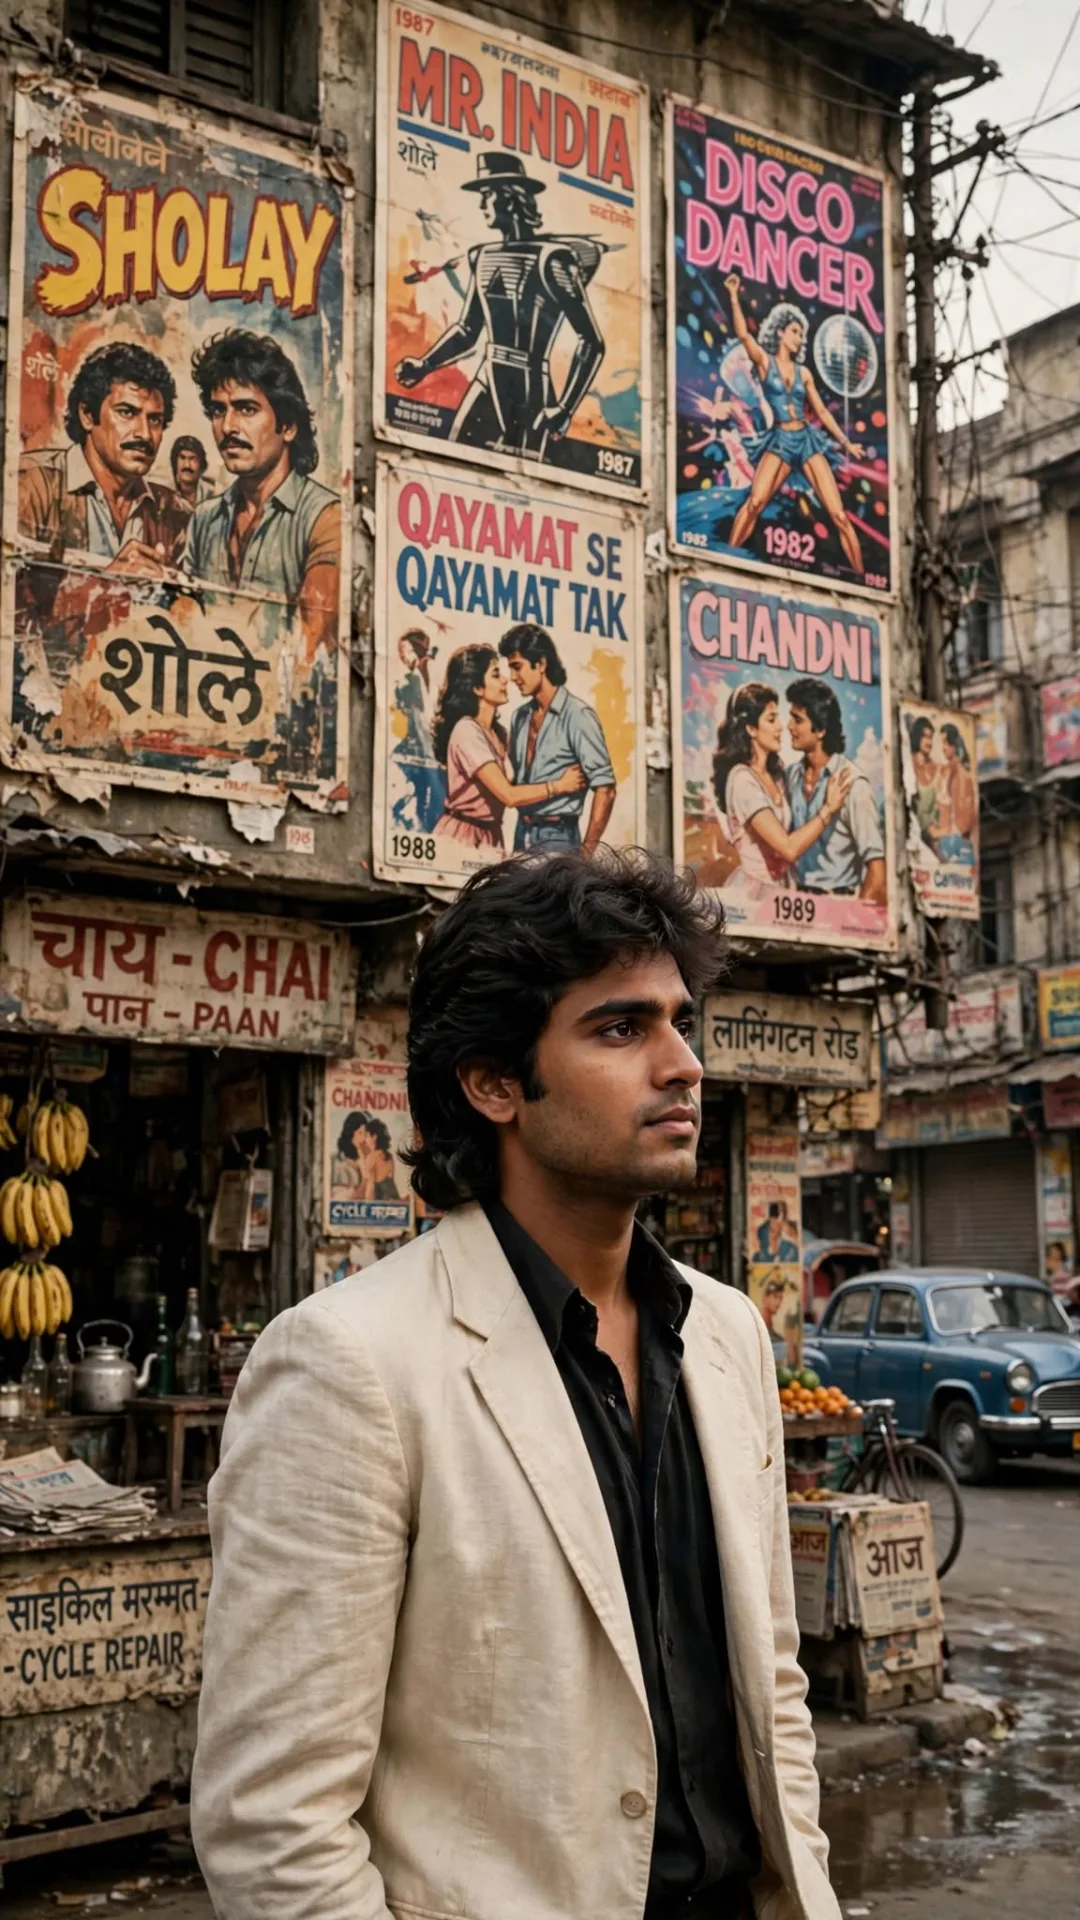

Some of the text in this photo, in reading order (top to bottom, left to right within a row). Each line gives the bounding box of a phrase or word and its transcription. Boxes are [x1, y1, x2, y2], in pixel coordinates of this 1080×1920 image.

[394, 8, 436, 37] 1987
[397, 136, 440, 171] शोले
[705, 137, 855, 245] DISCO
[34, 163, 339, 319] SHOLAY
[686, 198, 884, 334] DANCER
[597, 449, 635, 477] 1987
[397, 481, 623, 582] QAYAMAT SE
[681, 531, 708, 548] 1982
[763, 525, 816, 563] 1982
[396, 545, 629, 642] QAYAMAT TAK
[686, 589, 874, 685] CHANDNI
[99, 614, 272, 727] शोले
[391, 834, 437, 861] 1988
[773, 895, 816, 923] 1989
[31, 911, 166, 986] चाय
[204, 930, 331, 1001] CHAI
[82, 991, 155, 1029] पान
[193, 1002, 280, 1039] PAAN
[823, 1015, 861, 1061] रोड
[331, 1087, 408, 1113] CHANDNI
[866, 1535, 925, 1578] आज
[6, 1577, 115, 1636] साइकिल
[105, 1631, 185, 1673] REPAIR
